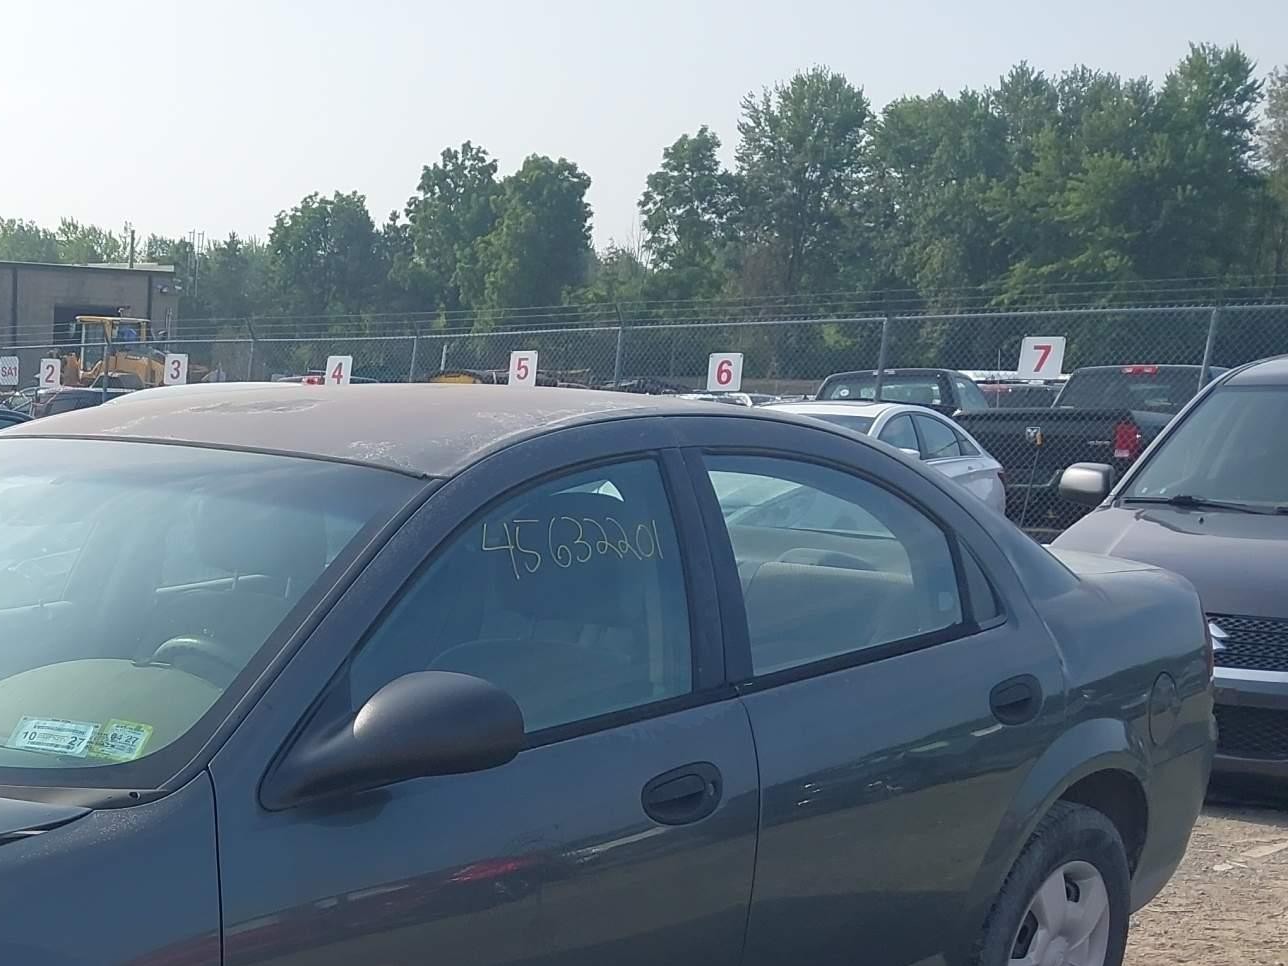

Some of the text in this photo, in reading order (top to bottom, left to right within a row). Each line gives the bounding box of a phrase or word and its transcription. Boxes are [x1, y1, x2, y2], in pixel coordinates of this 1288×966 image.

[516, 357, 529, 380] 5
[1033, 344, 1052, 372] 7
[1, 366, 18, 377] SA1
[45, 364, 55, 383] 2
[170, 359, 181, 380] 3
[331, 362, 344, 384] 4
[716, 359, 733, 385] 6
[481, 516, 664, 580] 45632201
[23, 731, 38, 741] 10
[68, 736, 87, 748] 27
